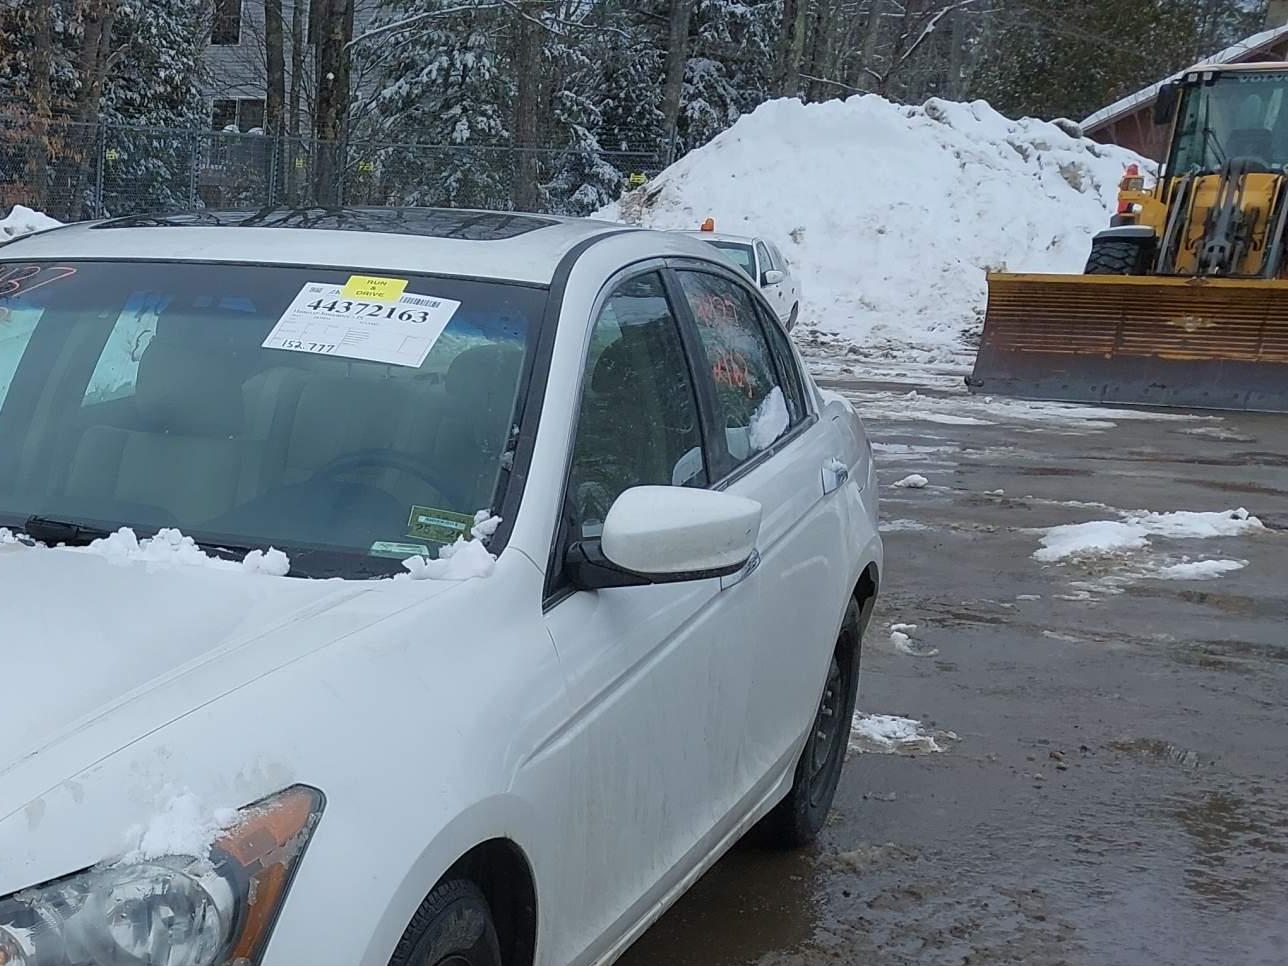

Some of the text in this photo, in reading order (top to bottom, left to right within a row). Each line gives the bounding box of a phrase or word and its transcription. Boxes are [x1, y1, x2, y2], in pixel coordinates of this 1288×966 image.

[366, 279, 388, 287] RUN
[355, 289, 386, 298] DRIVE
[307, 298, 430, 324] 44372163
